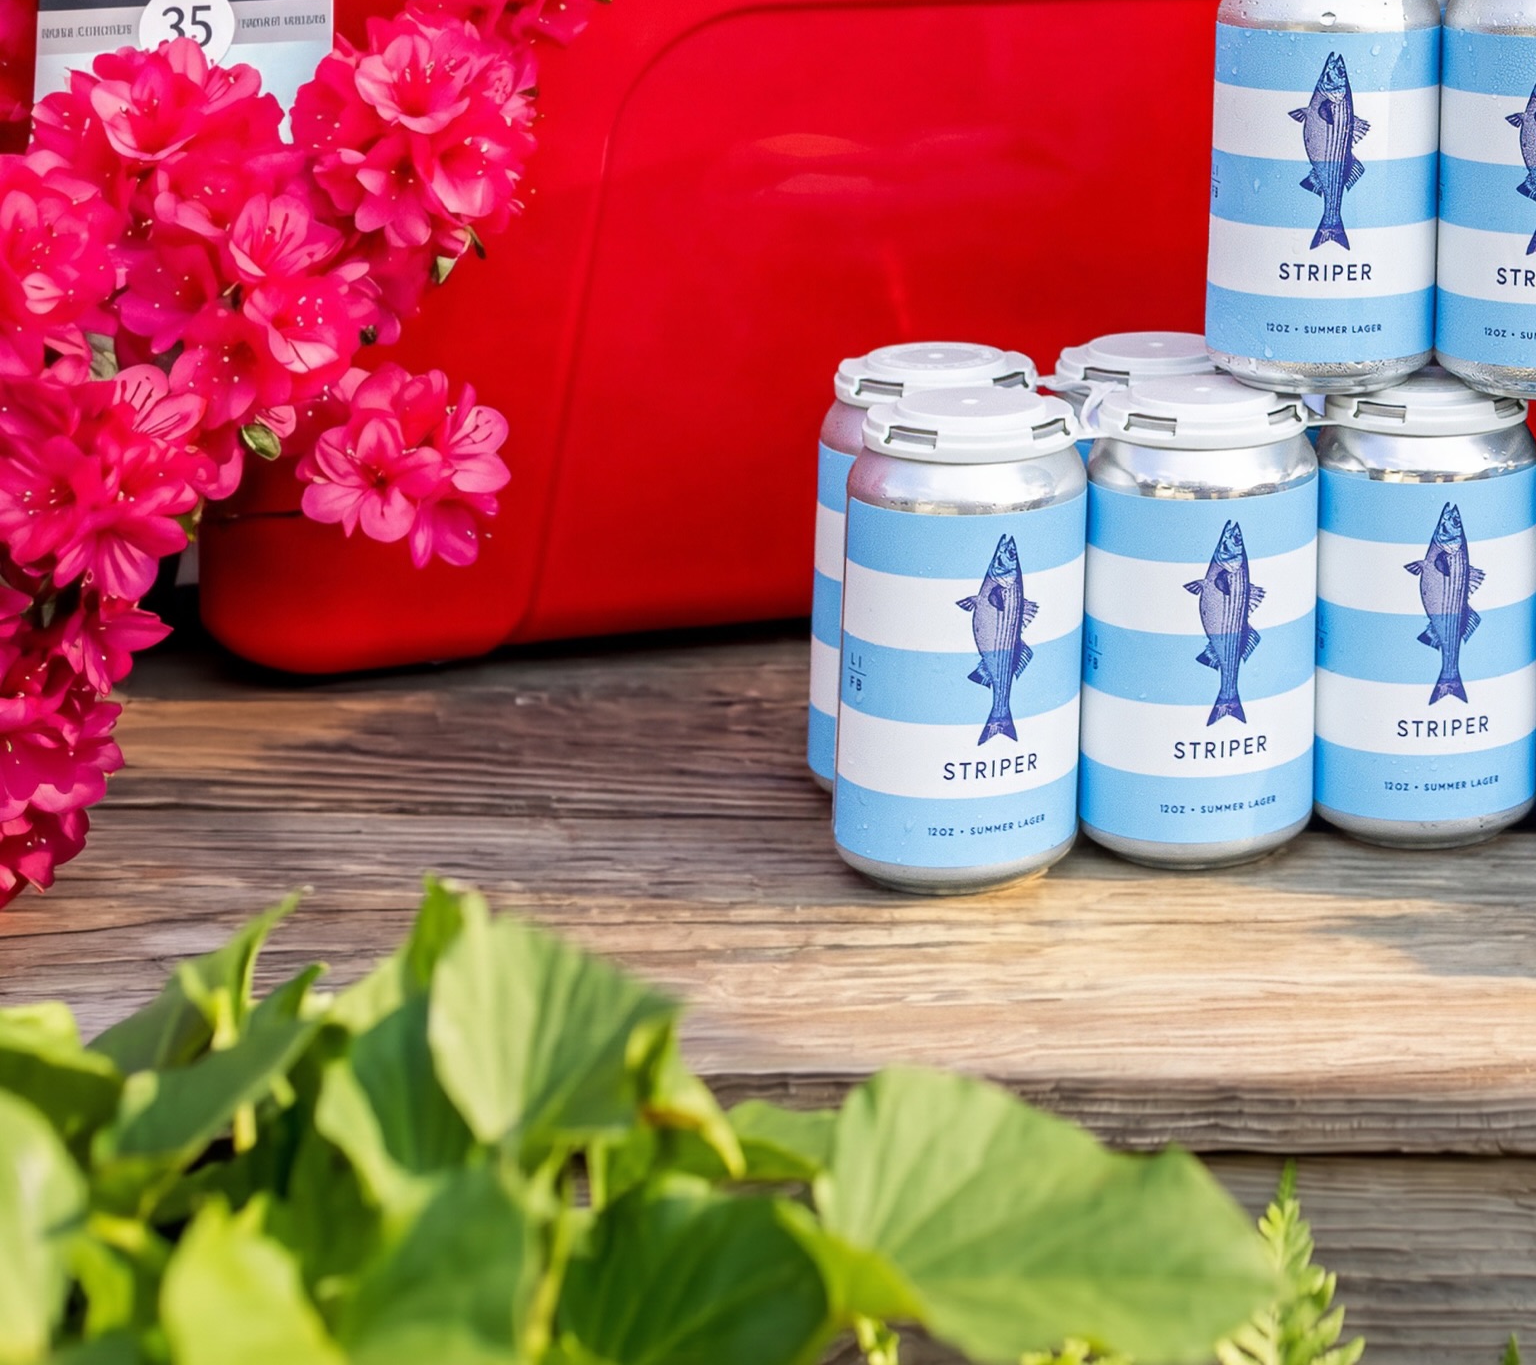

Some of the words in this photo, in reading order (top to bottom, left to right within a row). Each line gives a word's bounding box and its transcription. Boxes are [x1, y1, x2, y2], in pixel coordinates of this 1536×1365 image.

[162, 5, 213, 48] 35
[1279, 262, 1372, 282] STRIPER
[1267, 323, 1289, 334] 12OZ
[1304, 325, 1348, 335] SUMMER
[1352, 324, 1382, 334] LAGER
[1484, 327, 1507, 338] 12OZ
[1396, 715, 1489, 738] STRIPER
[1173, 735, 1267, 760] STRIPER
[943, 753, 1038, 781] STRIPER
[1384, 781, 1410, 792] 12OZ
[1424, 781, 1468, 792] SUMMER
[1471, 775, 1499, 788] LAGER
[1160, 804, 1186, 814] 12OZ
[1200, 802, 1245, 814] SUMMER
[1248, 795, 1277, 809] LAGER
[928, 827, 955, 837] 12OZ
[970, 822, 1015, 836] SUMMER
[1018, 814, 1046, 829] LAGER
